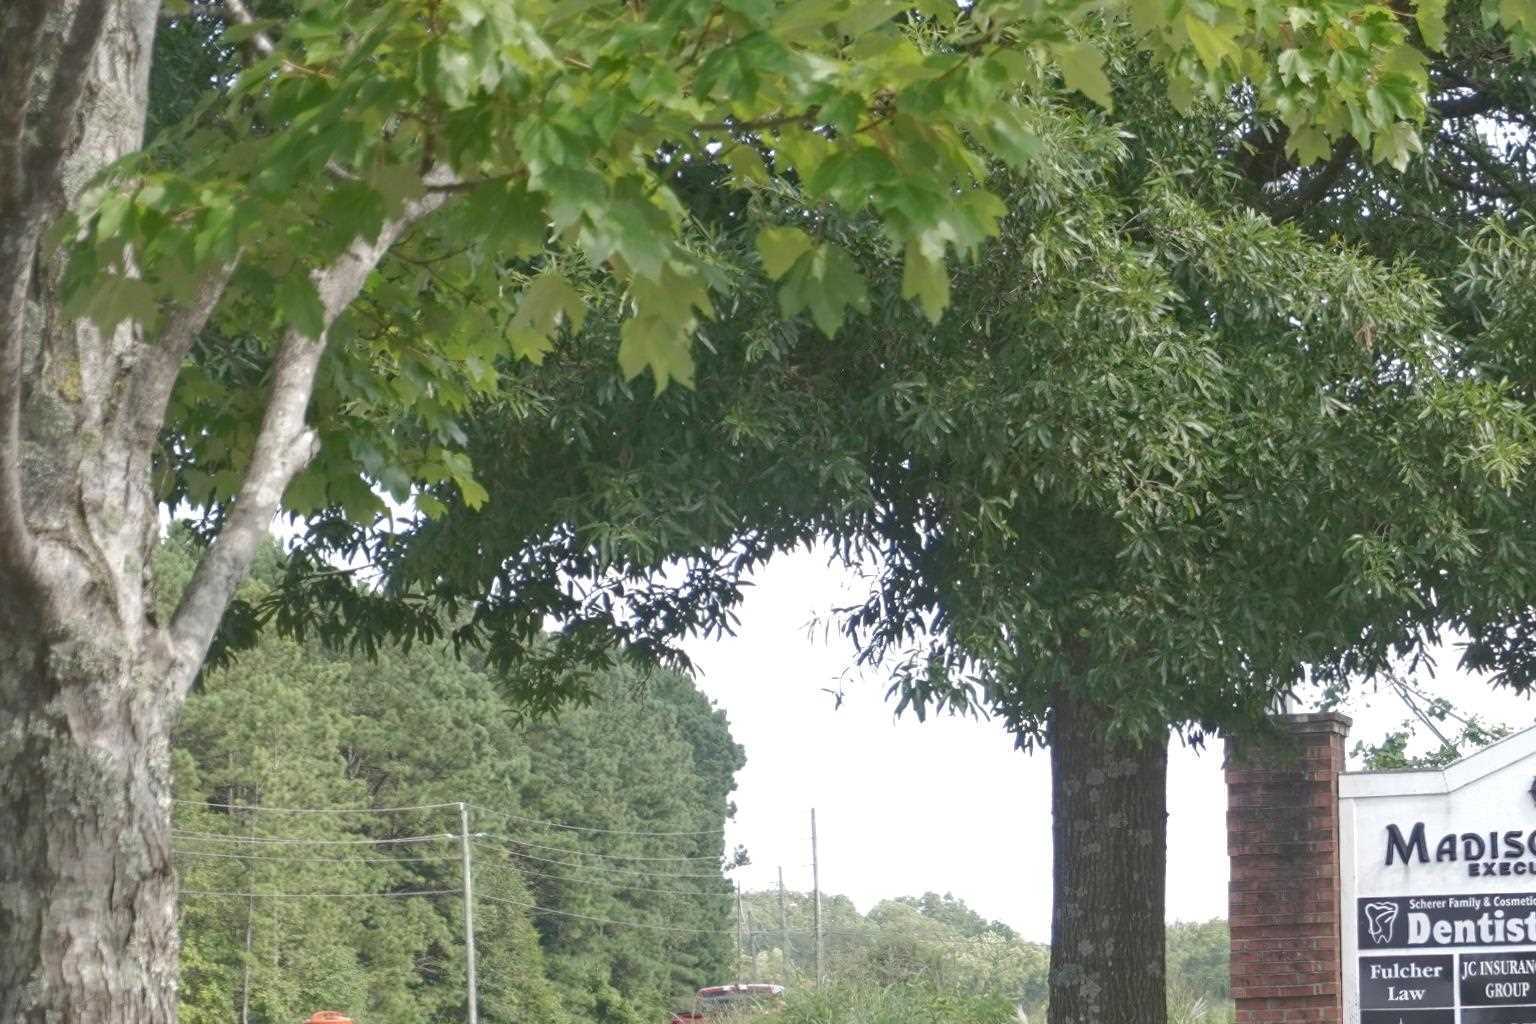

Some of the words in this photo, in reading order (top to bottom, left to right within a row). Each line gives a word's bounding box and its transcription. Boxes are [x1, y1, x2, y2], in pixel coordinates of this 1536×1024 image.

[1409, 899, 1446, 910] Scherer
[1449, 897, 1481, 910] Family
[1483, 896, 1491, 907] &
[1370, 963, 1443, 979] Fulcher
[1462, 961, 1478, 980] JC
[1387, 986, 1426, 1001] Law
[1485, 982, 1530, 998] GROUP
